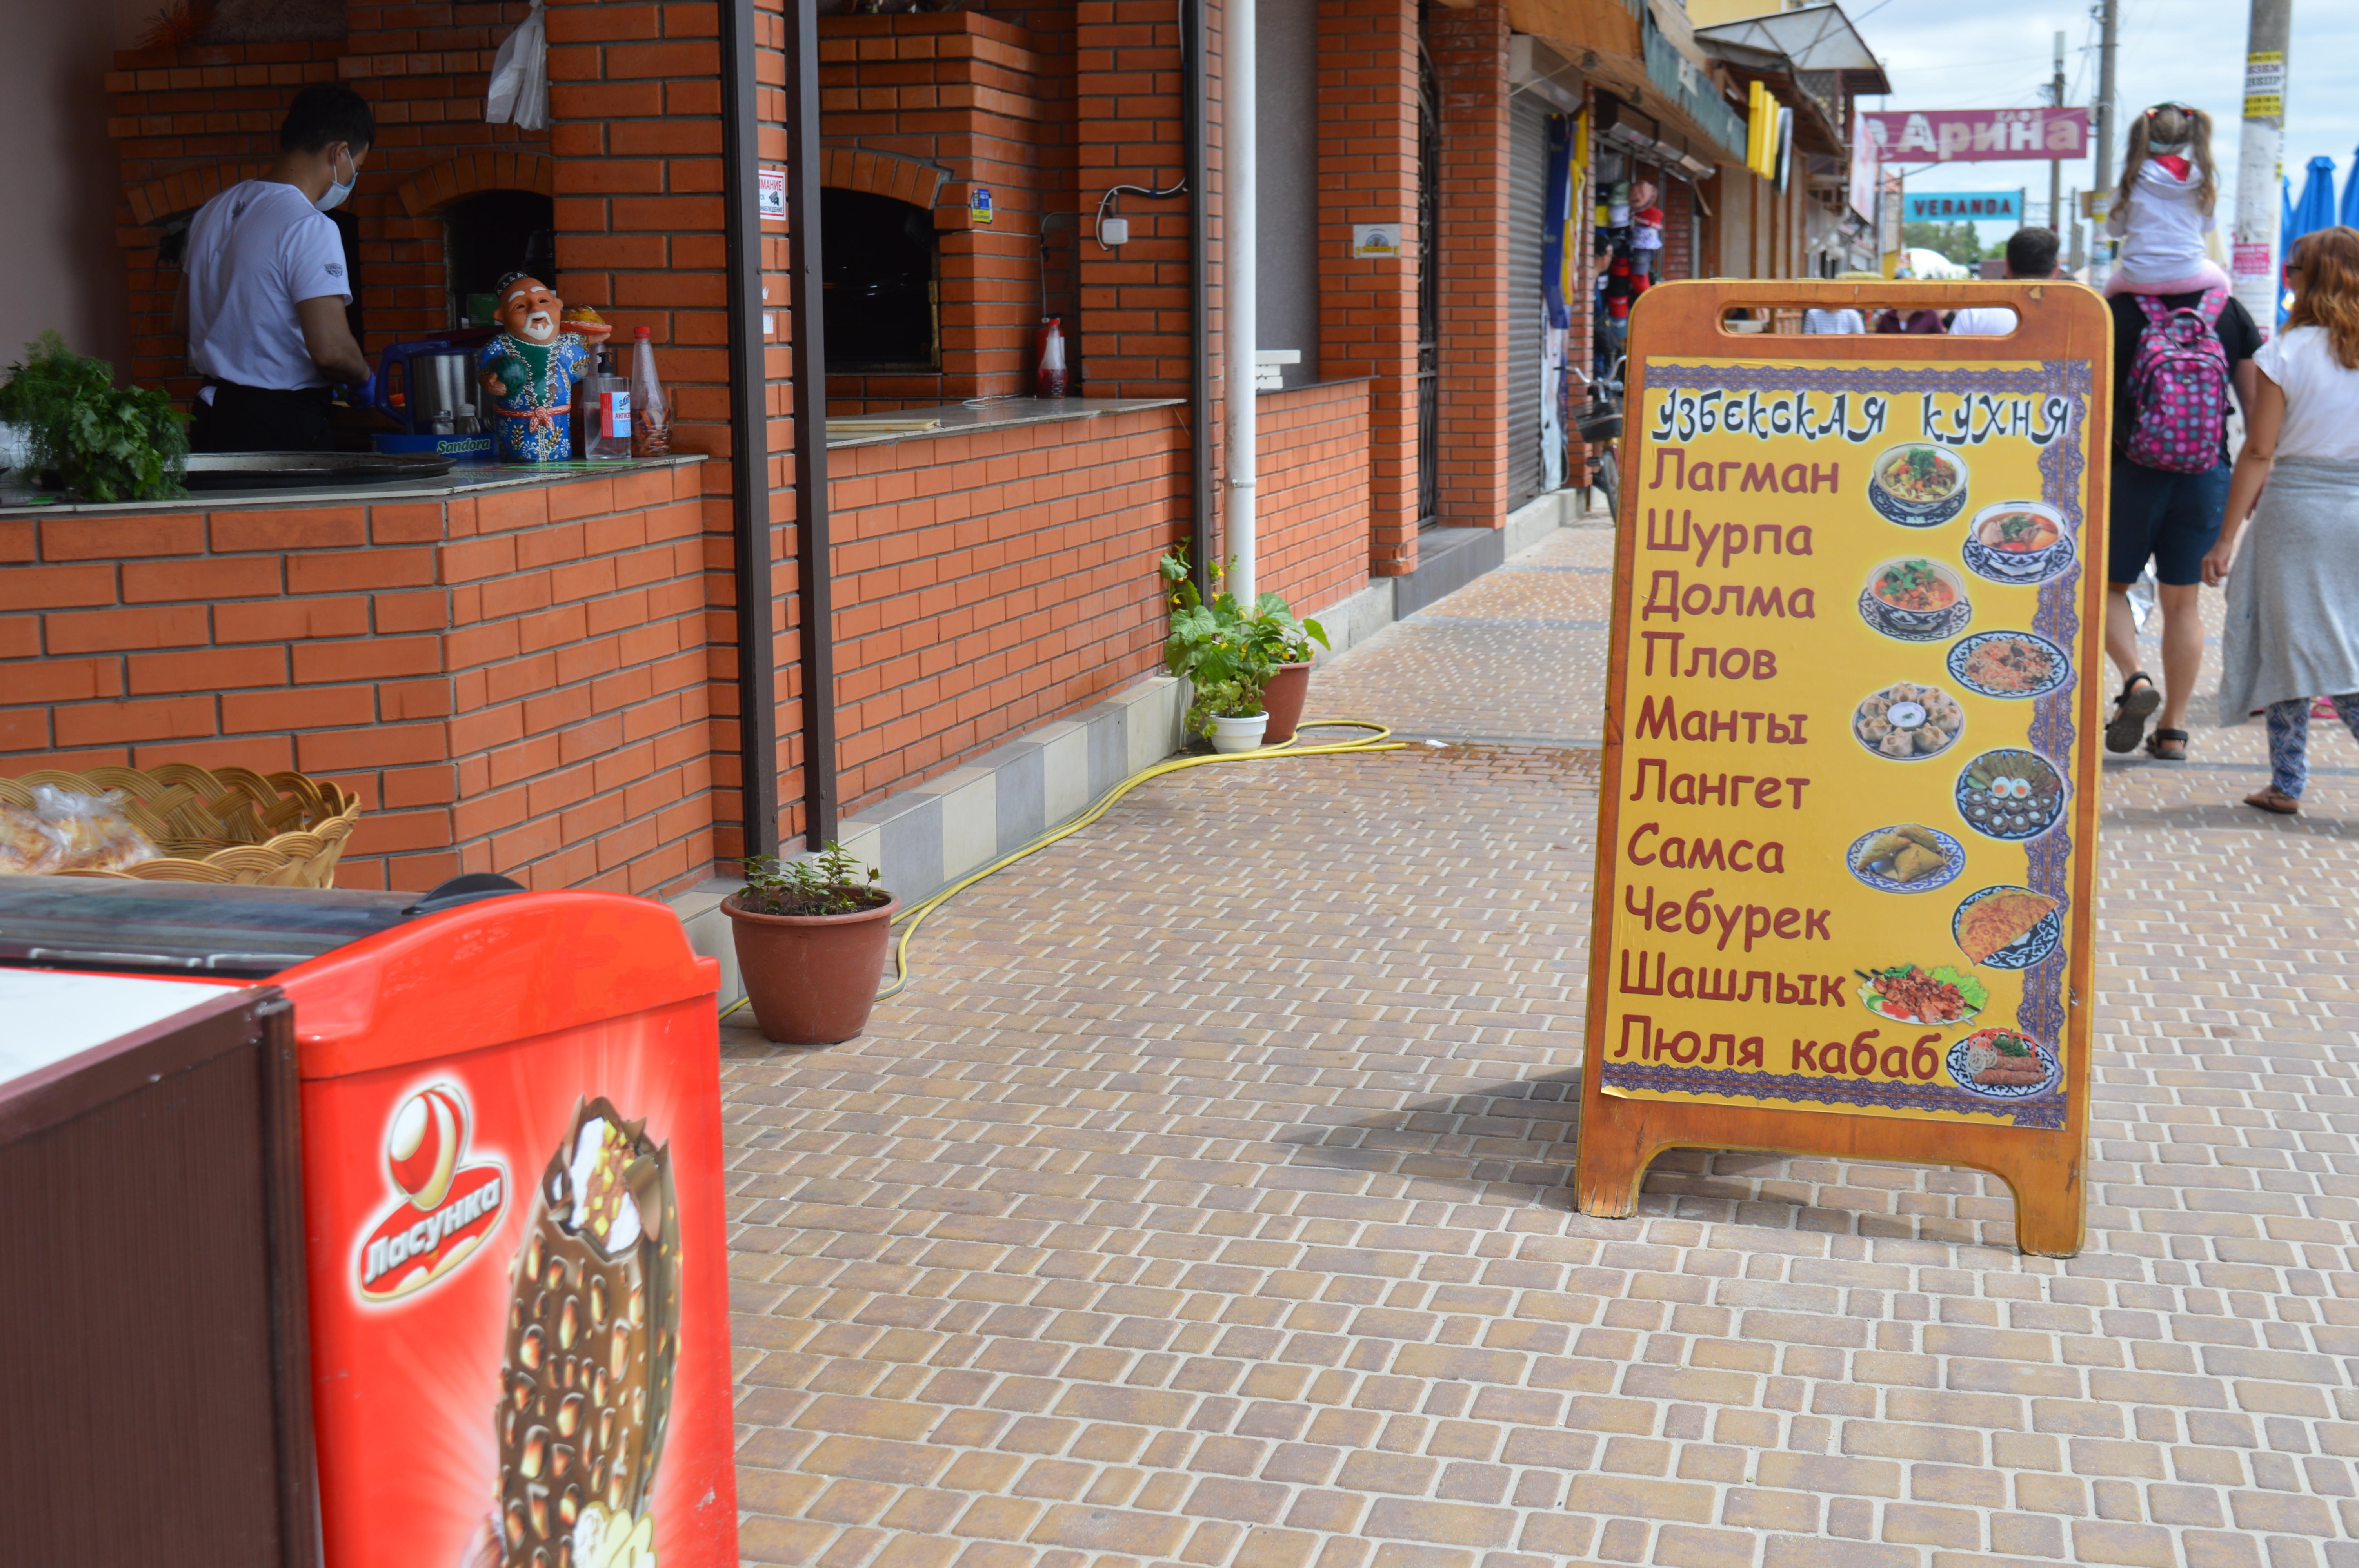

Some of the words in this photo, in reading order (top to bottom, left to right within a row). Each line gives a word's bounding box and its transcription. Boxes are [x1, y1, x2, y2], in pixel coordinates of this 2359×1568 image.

[1896, 113, 2080, 160] Арина
[1914, 198, 2013, 215] VERANDA
[1652, 388, 1886, 442] УЗБЕКСКАЯ
[1923, 391, 2070, 445] КУХНЯ
[437, 438, 491, 454] Sandora
[1649, 448, 1838, 493] Лагман
[1647, 508, 1813, 568] Шурпа
[1642, 570, 1815, 622] Долма
[1641, 631, 1777, 679] Плов
[1636, 695, 1808, 745] Манты
[1630, 758, 1810, 809] Лангет
[1627, 822, 1785, 874] Самса
[1625, 885, 1831, 953] Чебурек
[1619, 949, 1846, 1007] Шашлык
[1614, 1014, 1764, 1068] Люля
[1792, 1029, 1942, 1080] кабаб
[364, 1177, 501, 1286] Ласунка
